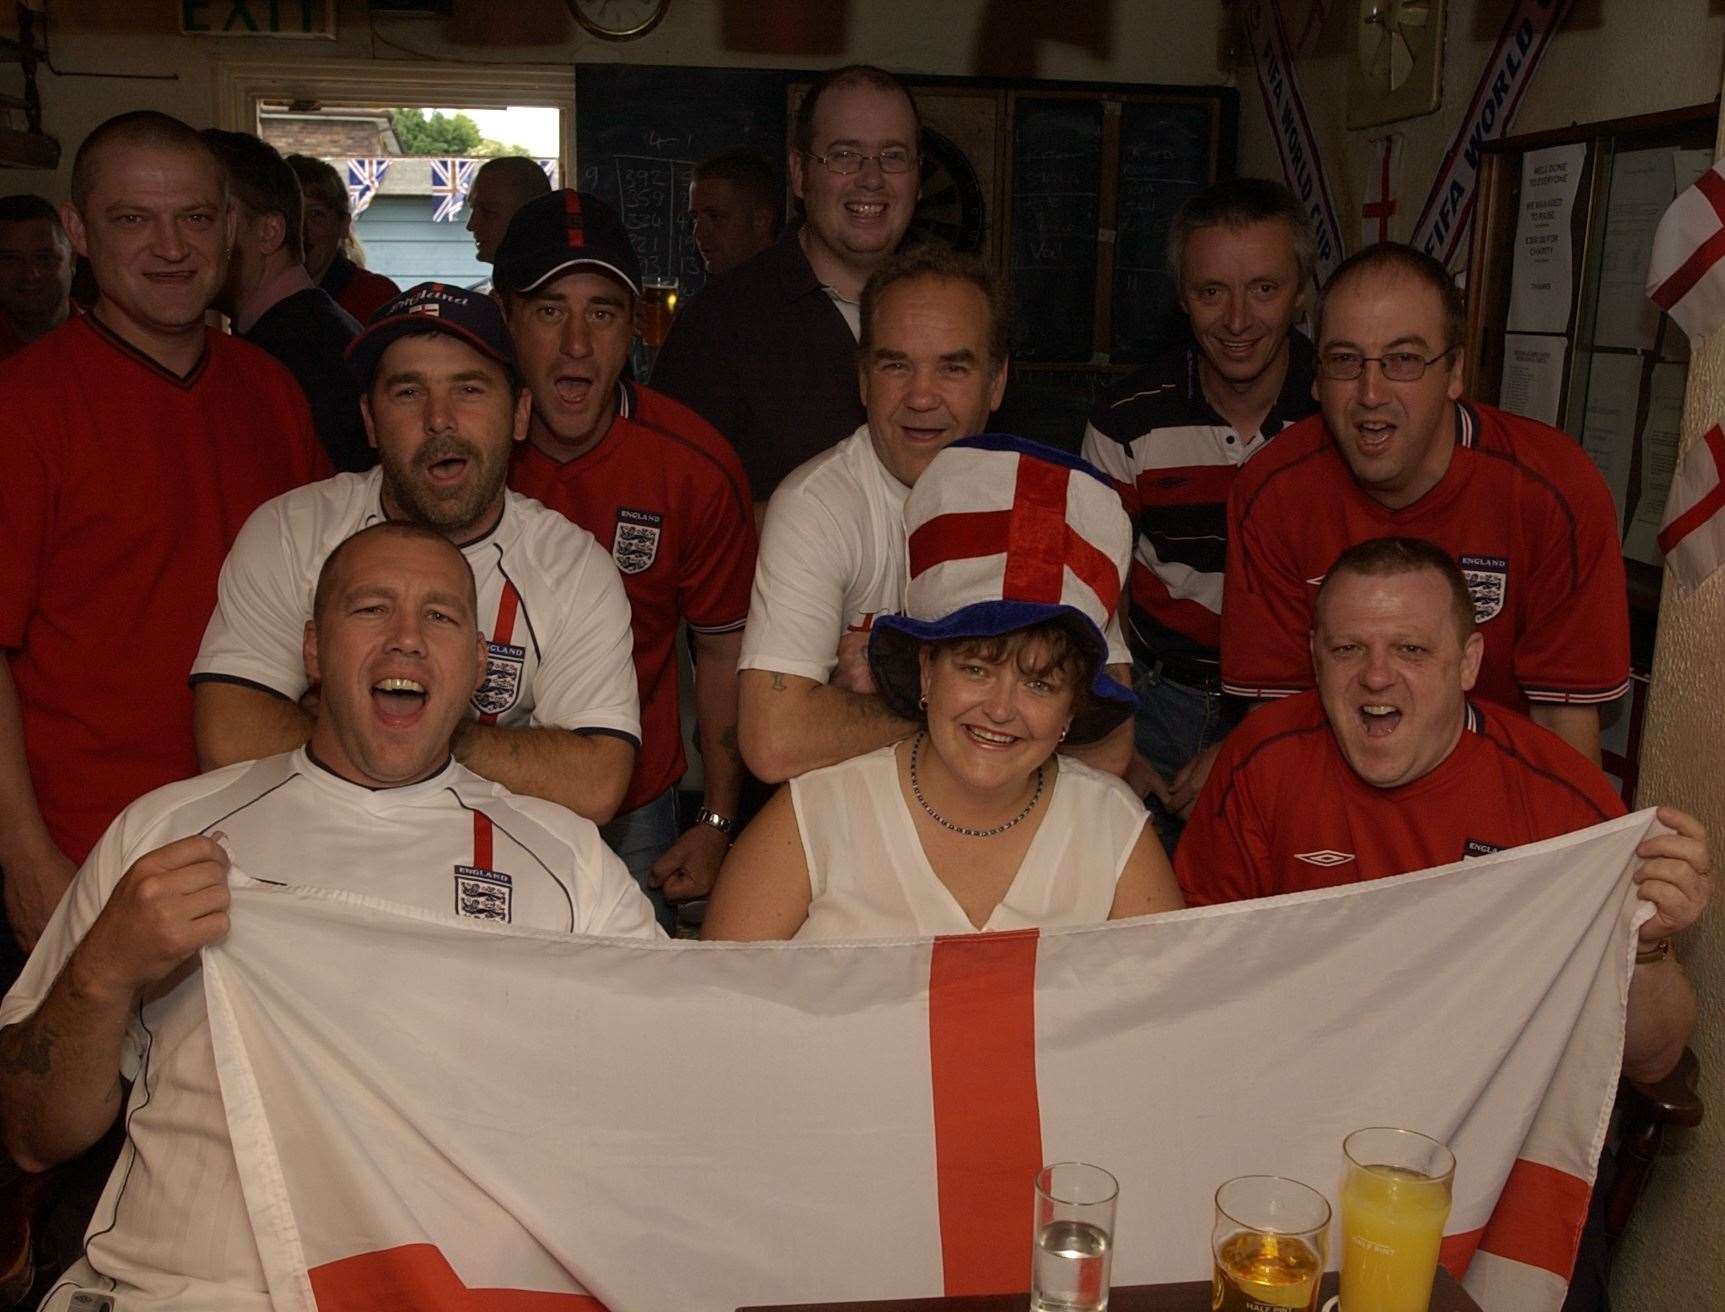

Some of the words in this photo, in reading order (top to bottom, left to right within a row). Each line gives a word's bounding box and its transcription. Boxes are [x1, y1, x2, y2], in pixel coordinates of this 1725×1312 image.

[1424, 180, 1465, 259] FIFA
[1464, 17, 1534, 170] WORLD
[1281, 100, 1312, 201] WORLD
[620, 509, 661, 523] ENGLAND
[1461, 556, 1507, 568] ENGLAND
[486, 644, 524, 656] GLAND
[1468, 841, 1500, 853] ENGLA
[458, 866, 509, 882] ENGLAND
